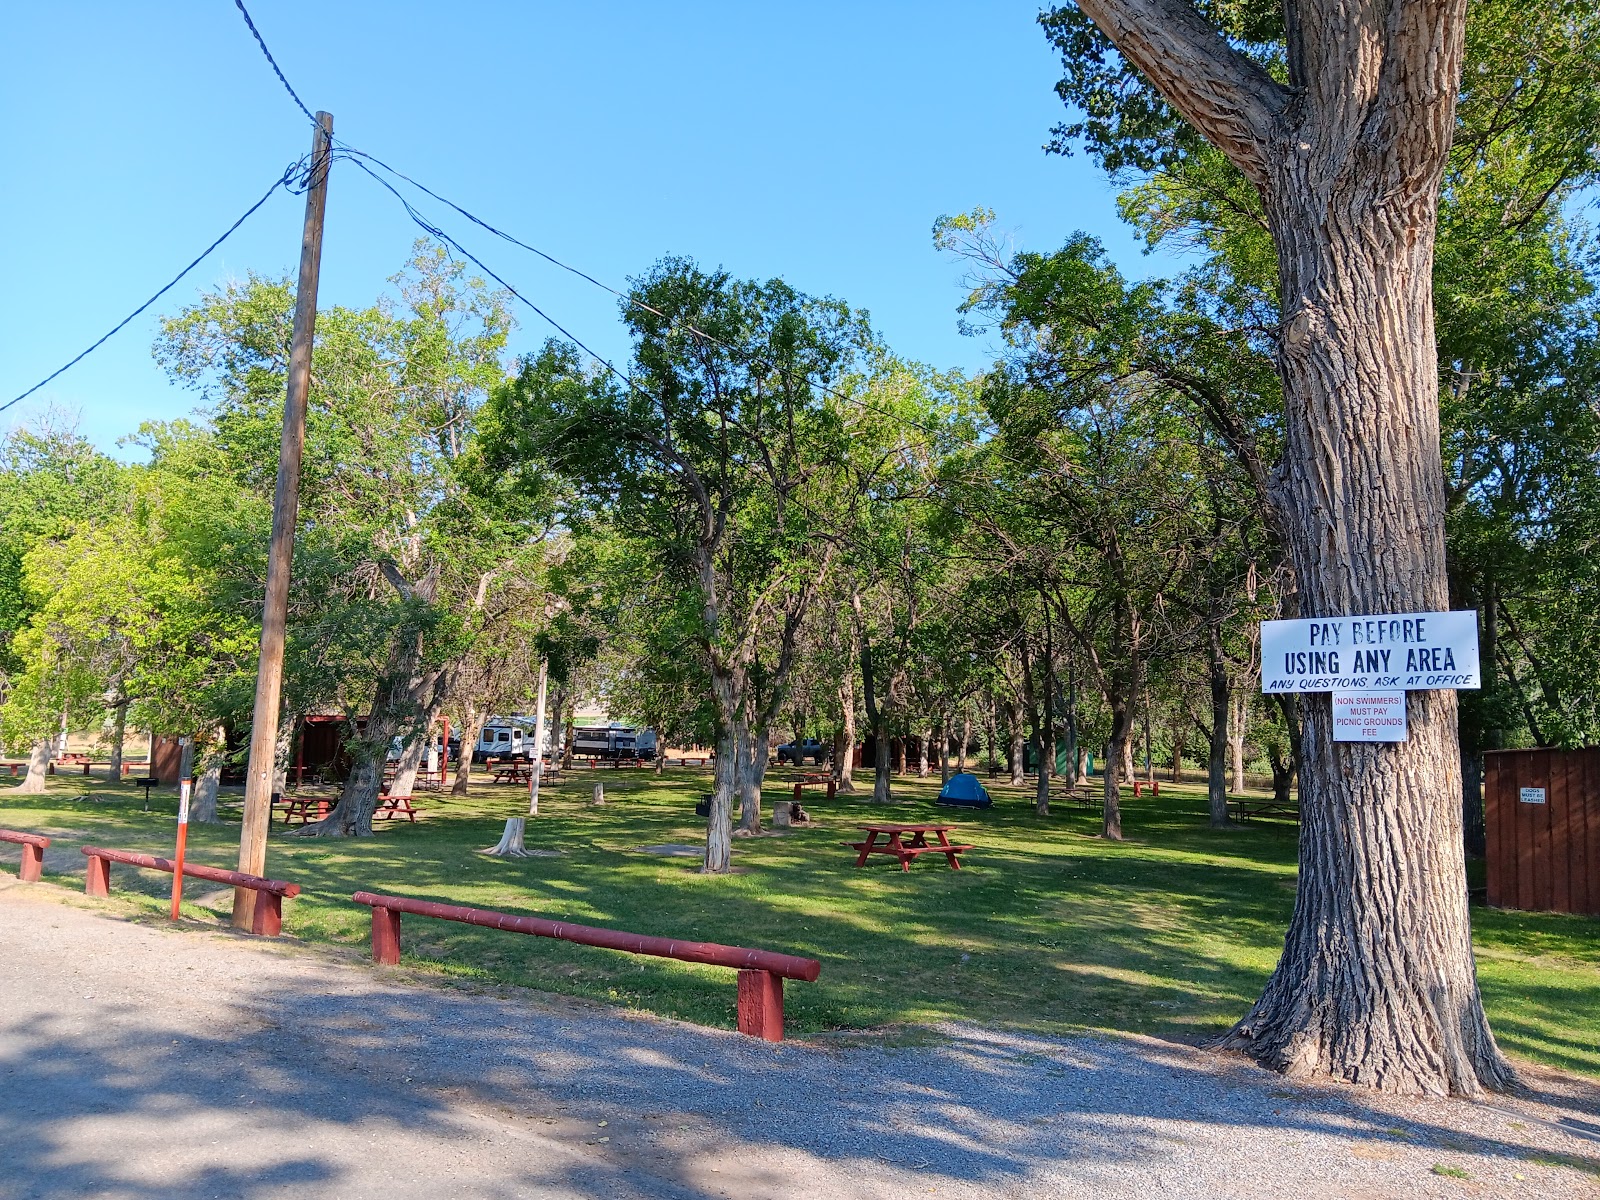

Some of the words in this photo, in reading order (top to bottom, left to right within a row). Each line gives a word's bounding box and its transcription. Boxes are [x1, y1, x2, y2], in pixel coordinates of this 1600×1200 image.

[1310, 623, 1343, 646] PAY
[1352, 619, 1427, 644] BEFORE
[1285, 651, 1340, 674] USING
[1353, 649, 1391, 673] ANY
[1406, 647, 1456, 672] AREA
[1269, 679, 1294, 689] ANY
[1374, 676, 1400, 686] ASK
[1406, 675, 1422, 685] AT
[1334, 697, 1354, 705] (NON
[1355, 696, 1402, 705] SWIMMERS)
[1350, 707, 1371, 715] MUST
[1373, 707, 1388, 715] PAY
[1336, 718, 1362, 726] PICNIC
[1363, 718, 1403, 726] GROUNDS
[1362, 728, 1377, 736] FEE
